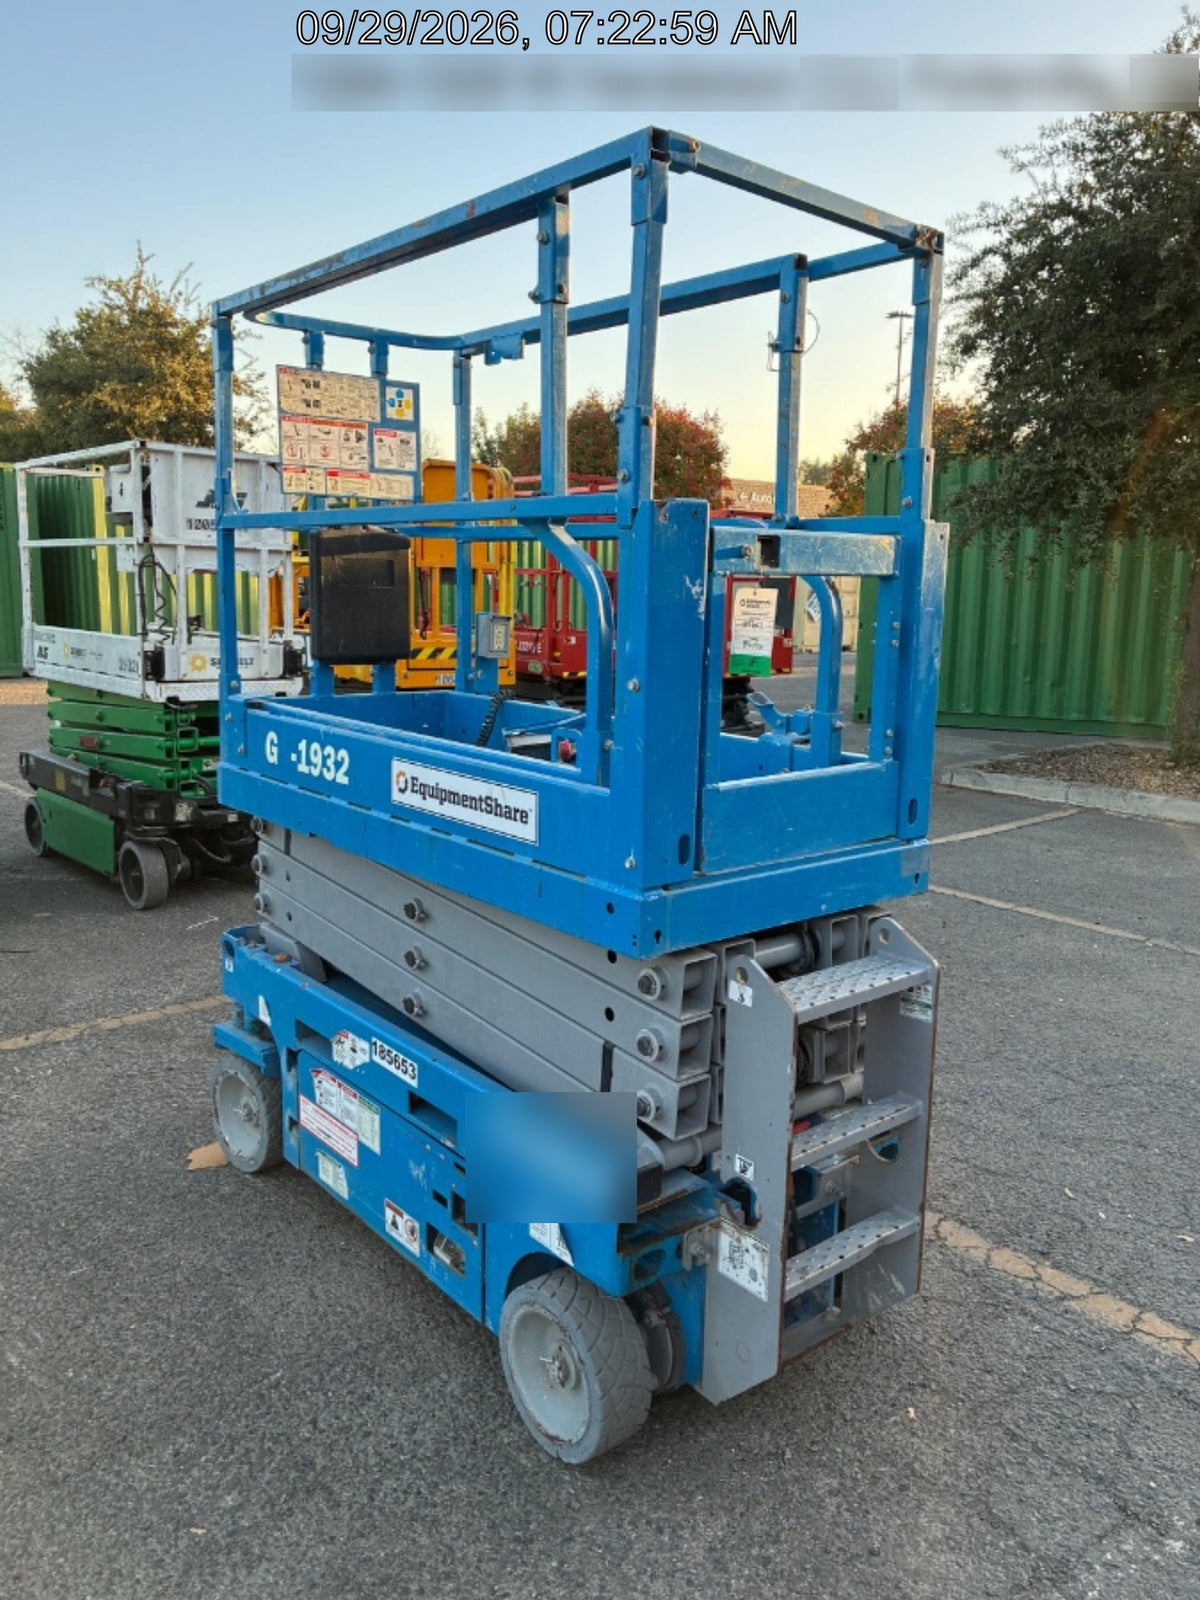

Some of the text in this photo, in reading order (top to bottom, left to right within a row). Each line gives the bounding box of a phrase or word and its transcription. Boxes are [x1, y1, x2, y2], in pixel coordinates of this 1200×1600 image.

[290, 738, 350, 786] -1932
[410, 776, 530, 825] EquipmentShare
[372, 1040, 417, 1080] 185653
